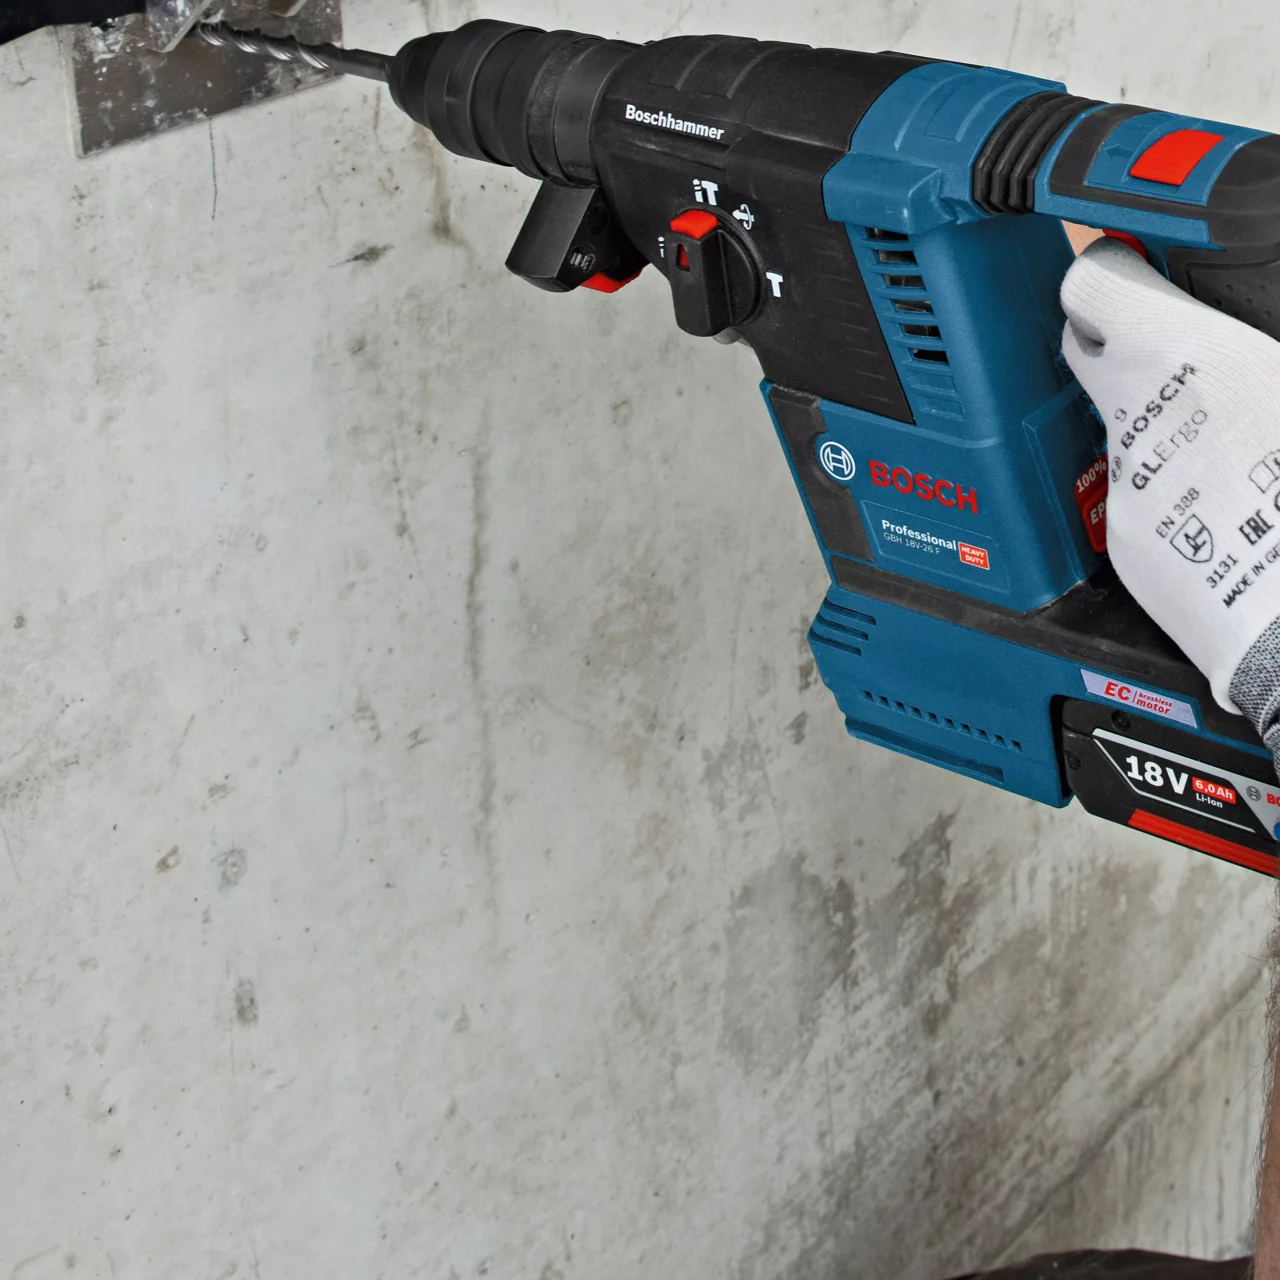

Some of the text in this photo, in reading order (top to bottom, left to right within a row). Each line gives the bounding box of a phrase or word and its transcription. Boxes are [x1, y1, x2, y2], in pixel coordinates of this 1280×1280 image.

[625, 104, 725, 140] Boschhammer
[1120, 363, 1196, 450] BOSCH
[868, 459, 979, 514] BOSCH
[1076, 459, 1107, 493] 100%
[1155, 487, 1200, 538] EN 388
[881, 519, 957, 551] Professional
[883, 532, 903, 544] GBH
[905, 539, 934, 553] 18V-26
[961, 546, 985, 558] HEAVY
[965, 554, 984, 565] DUTY
[1206, 554, 1238, 589] 3131
[1222, 574, 1253, 608] MADE
[1251, 561, 1266, 577] IN
[1104, 681, 1132, 701] EC
[1136, 699, 1171, 714] motor
[1138, 692, 1173, 707] brushless
[1126, 755, 1189, 795] 18V
[1196, 792, 1223, 809] Li-Ion
